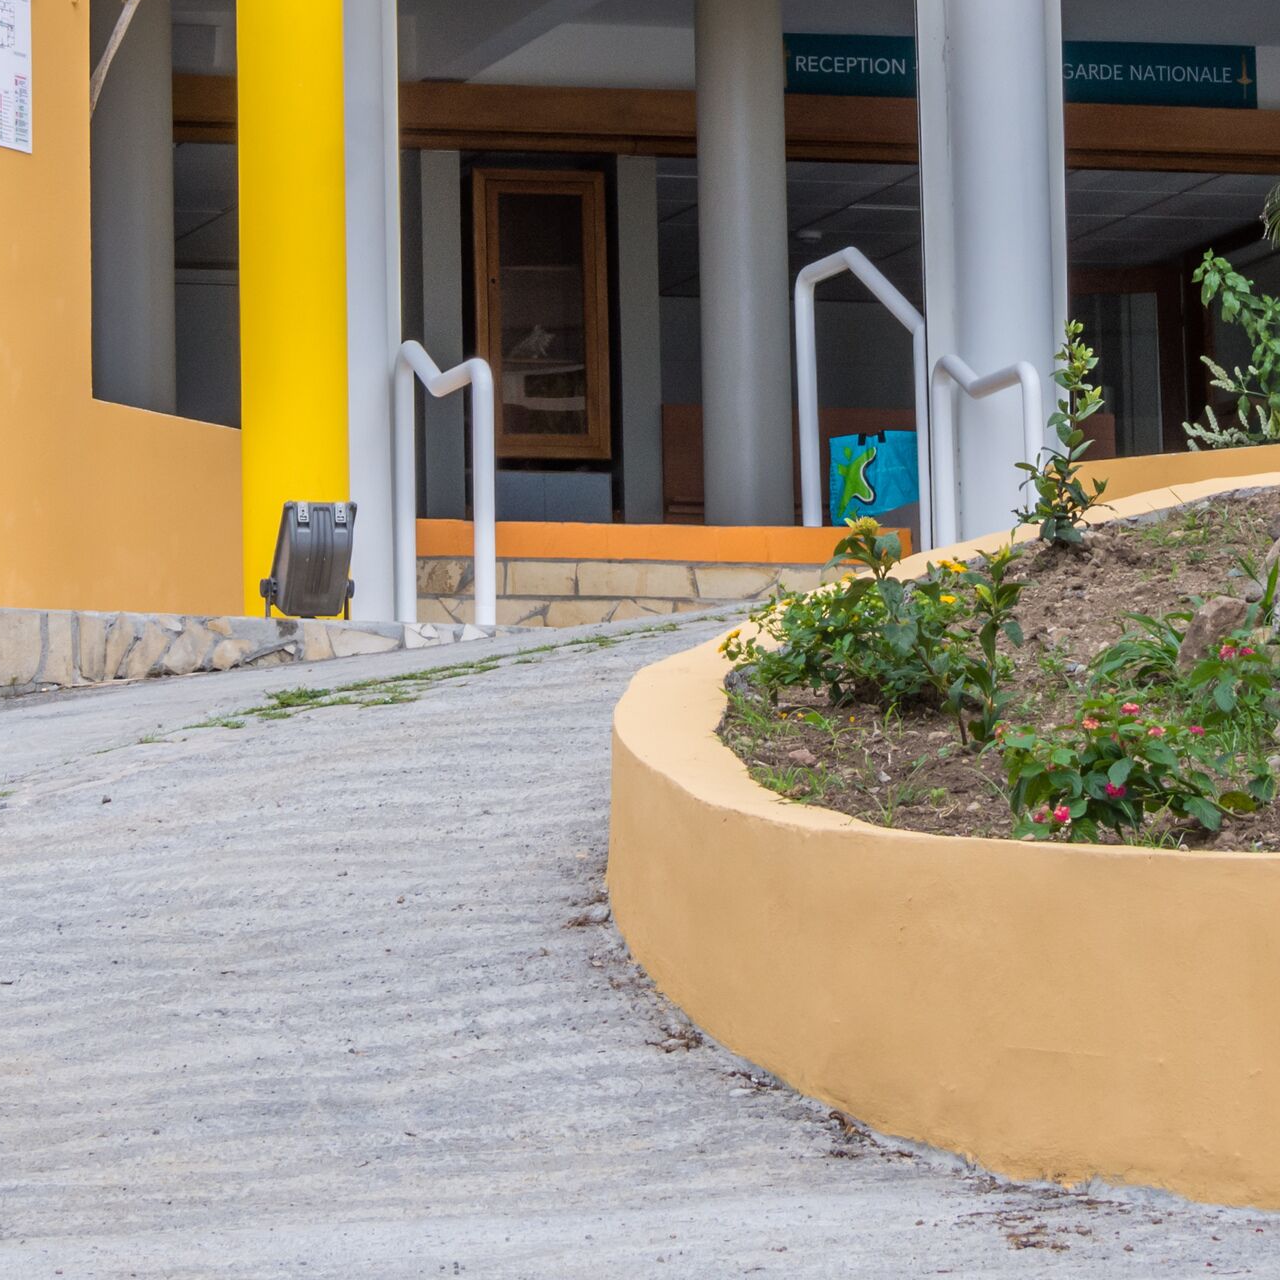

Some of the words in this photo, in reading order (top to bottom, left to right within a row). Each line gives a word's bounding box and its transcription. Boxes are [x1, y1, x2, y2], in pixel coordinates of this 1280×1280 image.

[795, 55, 906, 75] RECEPTION
[1063, 63, 1123, 81] GARDE
[1130, 65, 1233, 84] NATIONALE
